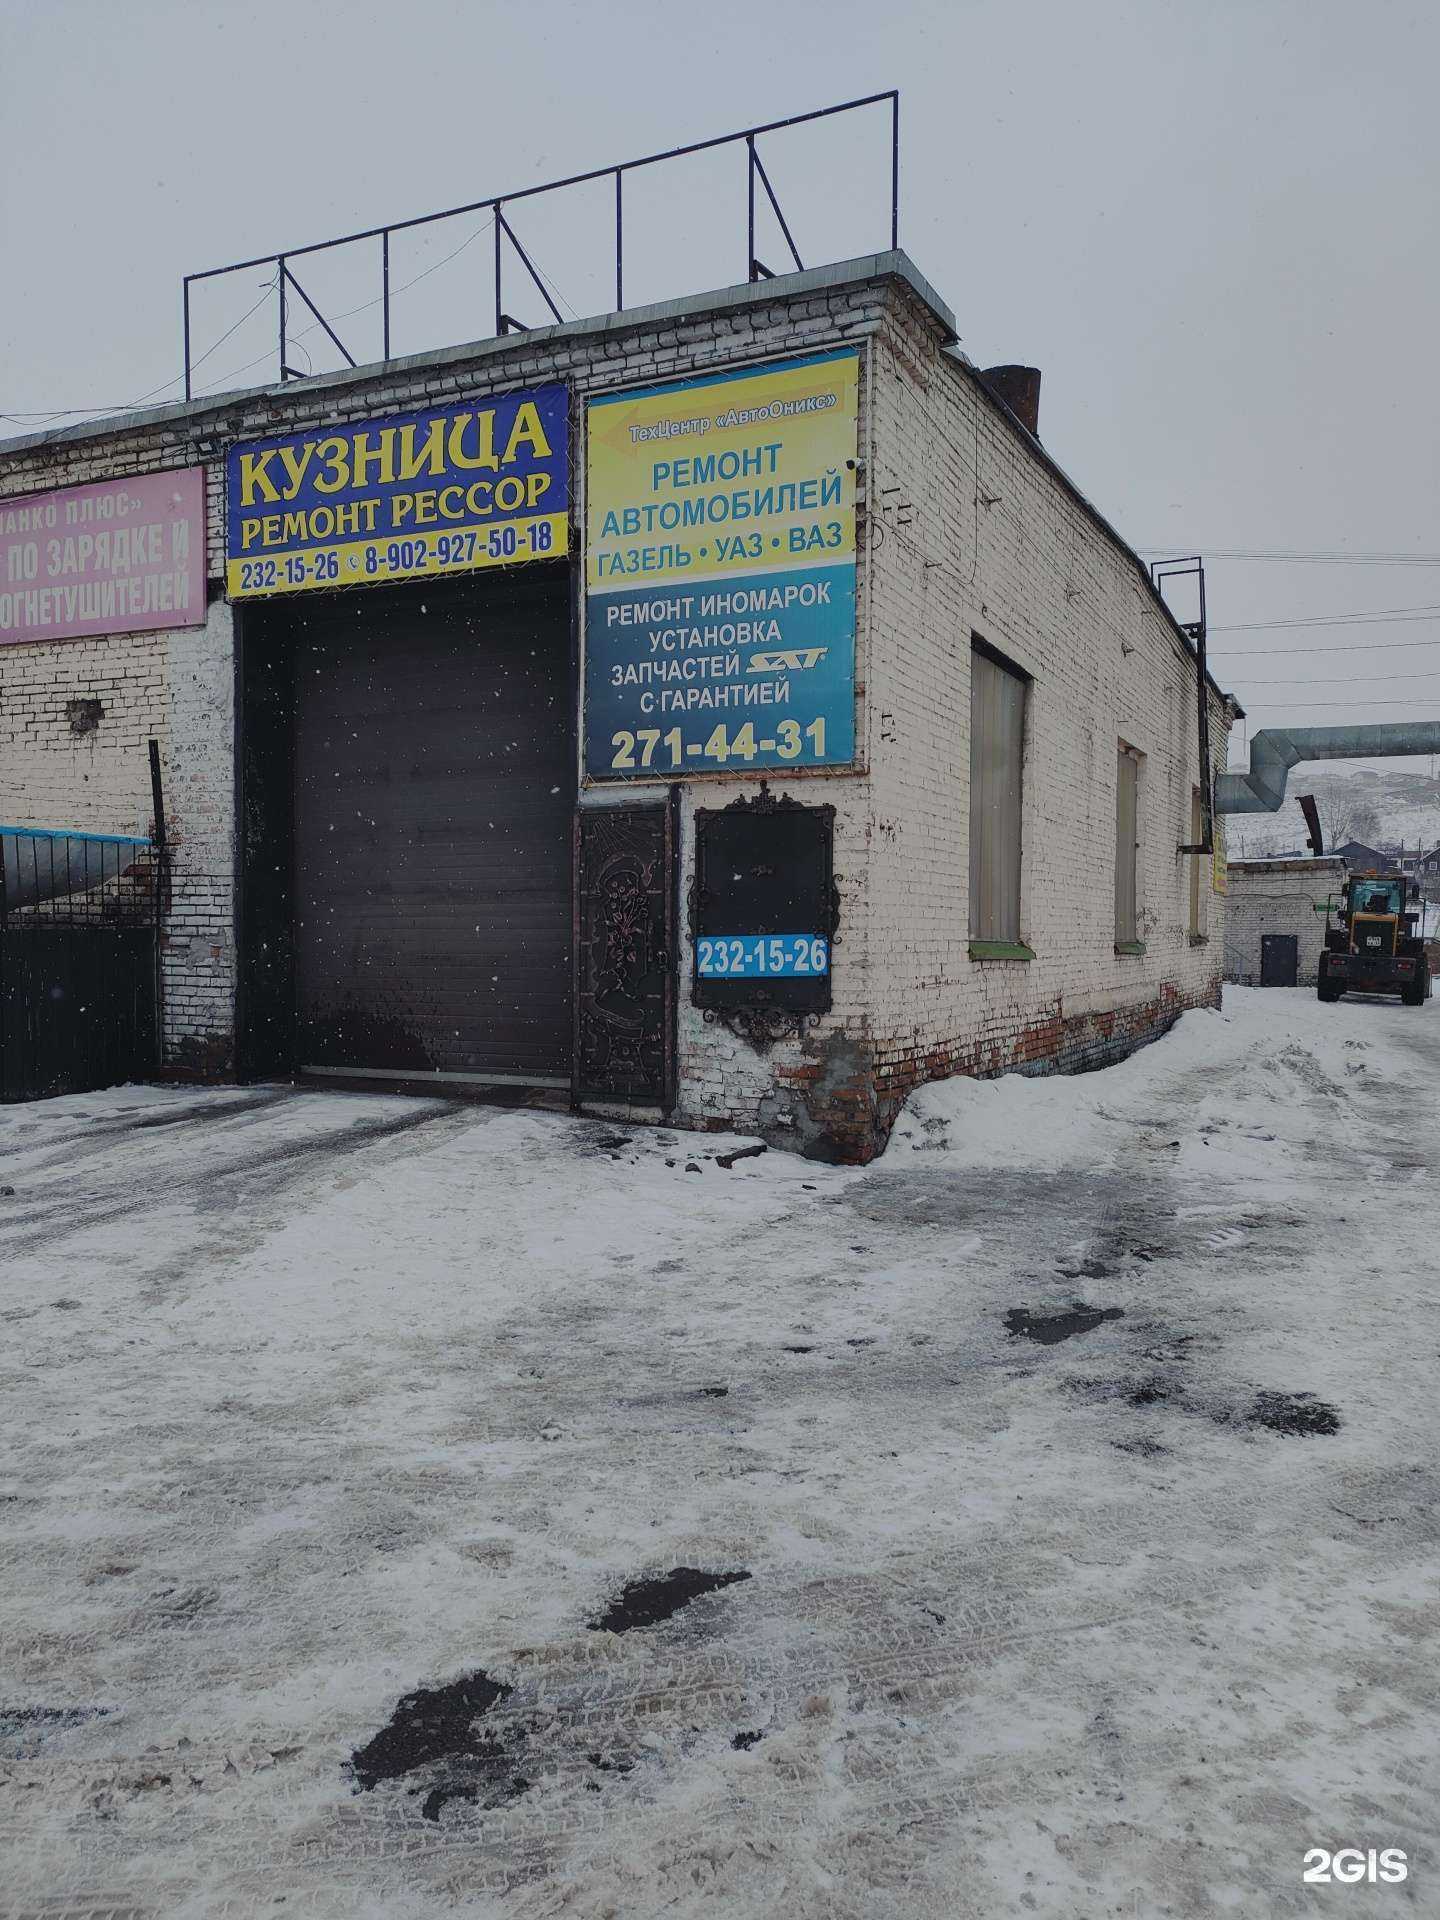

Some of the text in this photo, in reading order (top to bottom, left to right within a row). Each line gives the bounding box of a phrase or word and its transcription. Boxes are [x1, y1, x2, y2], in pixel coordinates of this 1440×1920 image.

[629, 394, 839, 442] ТехЦентр «АвтоОникс»
[239, 401, 553, 507] КУЗНИЦА
[653, 443, 783, 491] РЕМОНТ
[65, 493, 143, 525] ПЛЮС»
[241, 472, 552, 551] РЕМОНТ РЕССОР
[601, 467, 841, 538] АВТОМОБИЛЕЙ
[8, 542, 38, 581] ПО
[47, 523, 163, 577] ЗАРЯДКЕ
[241, 521, 552, 591] 232-15-26 8-902-927-50-18
[597, 522, 842, 577] ГАЗЕЛЬ УАЗ ВАЗ
[0, 563, 189, 630] ОГНЕТУШИТЕЛЕЙ
[607, 580, 831, 628] РЕМОНТ ИНОМАРОК
[650, 619, 782, 653] УСТАНОВКА
[611, 649, 740, 686] ЗАПЧАСТЕЙ
[640, 675, 790, 713] С ГАРАНТИЕЙ
[611, 717, 827, 769] 271-44-31
[698, 939, 827, 973] 232-15-26
